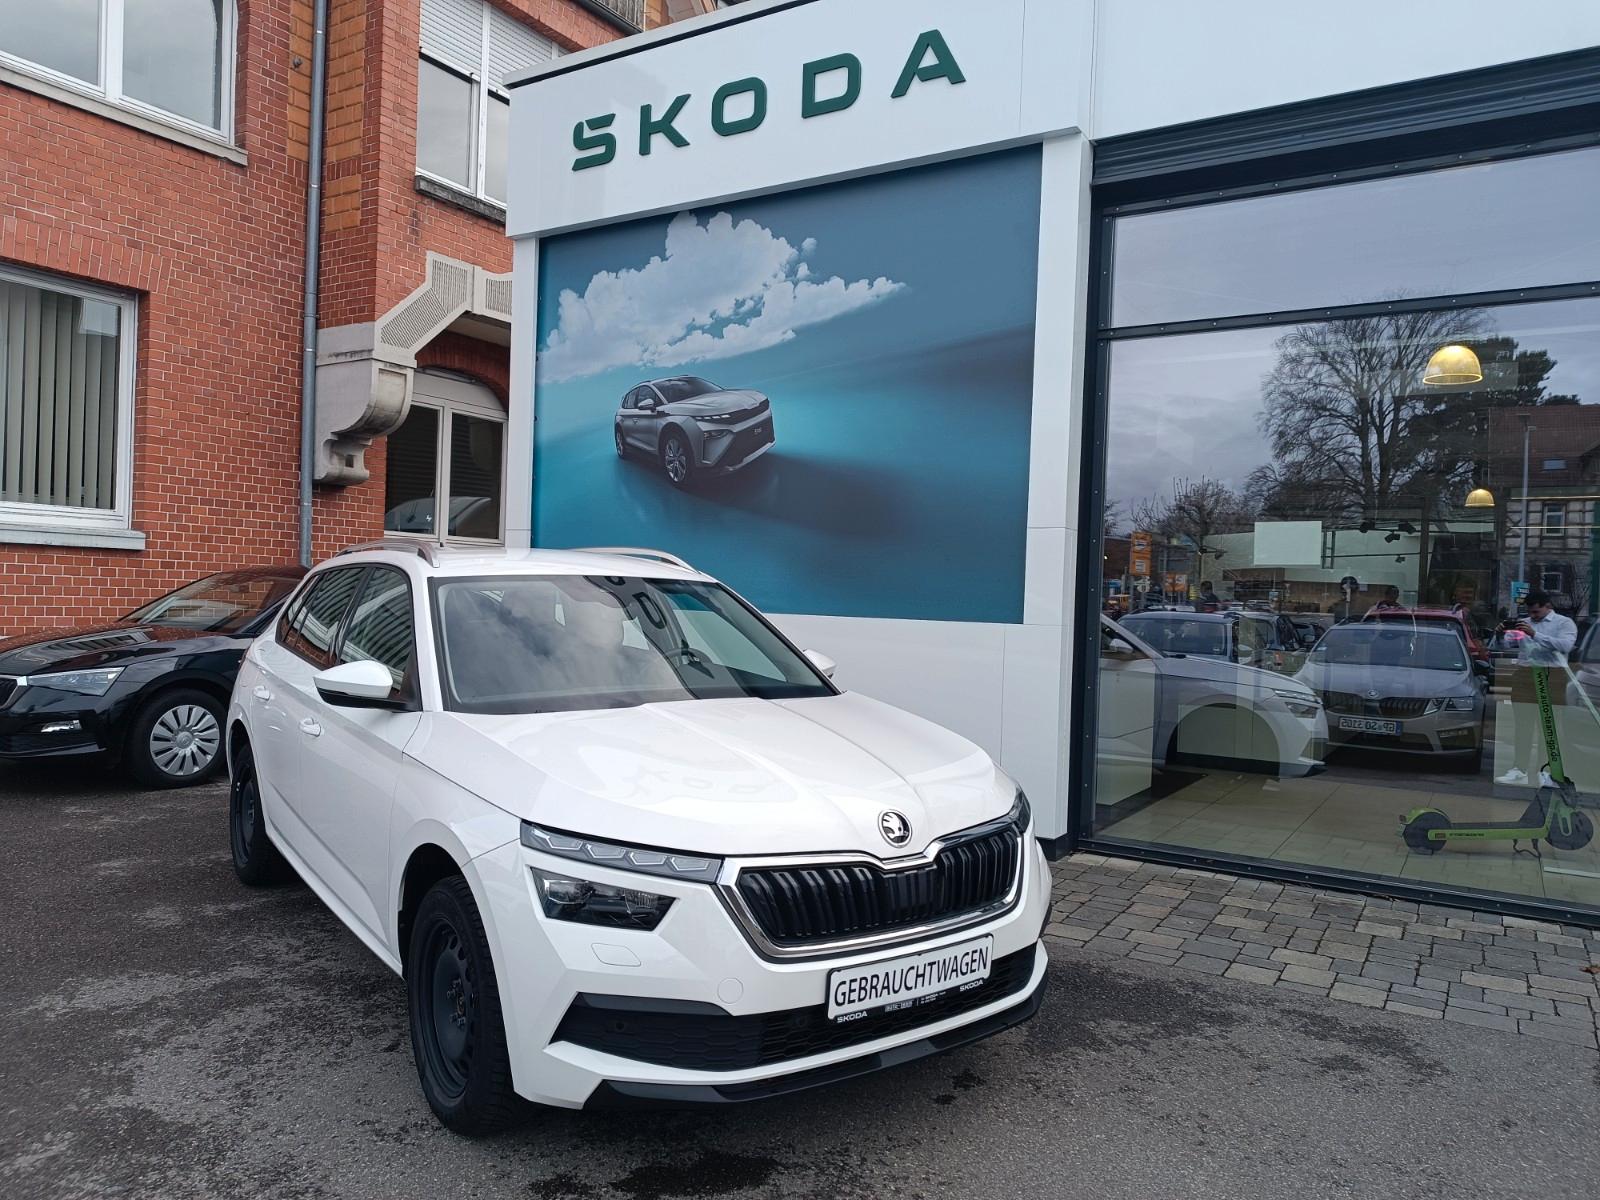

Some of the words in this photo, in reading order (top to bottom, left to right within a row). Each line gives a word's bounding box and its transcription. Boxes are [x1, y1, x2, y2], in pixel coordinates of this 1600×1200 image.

[572, 29, 966, 171] SKODA
[834, 946, 989, 1007] GEBRAUCHTWAGEN
[959, 979, 984, 992] SKODA
[836, 1010, 868, 1024] SKODA
